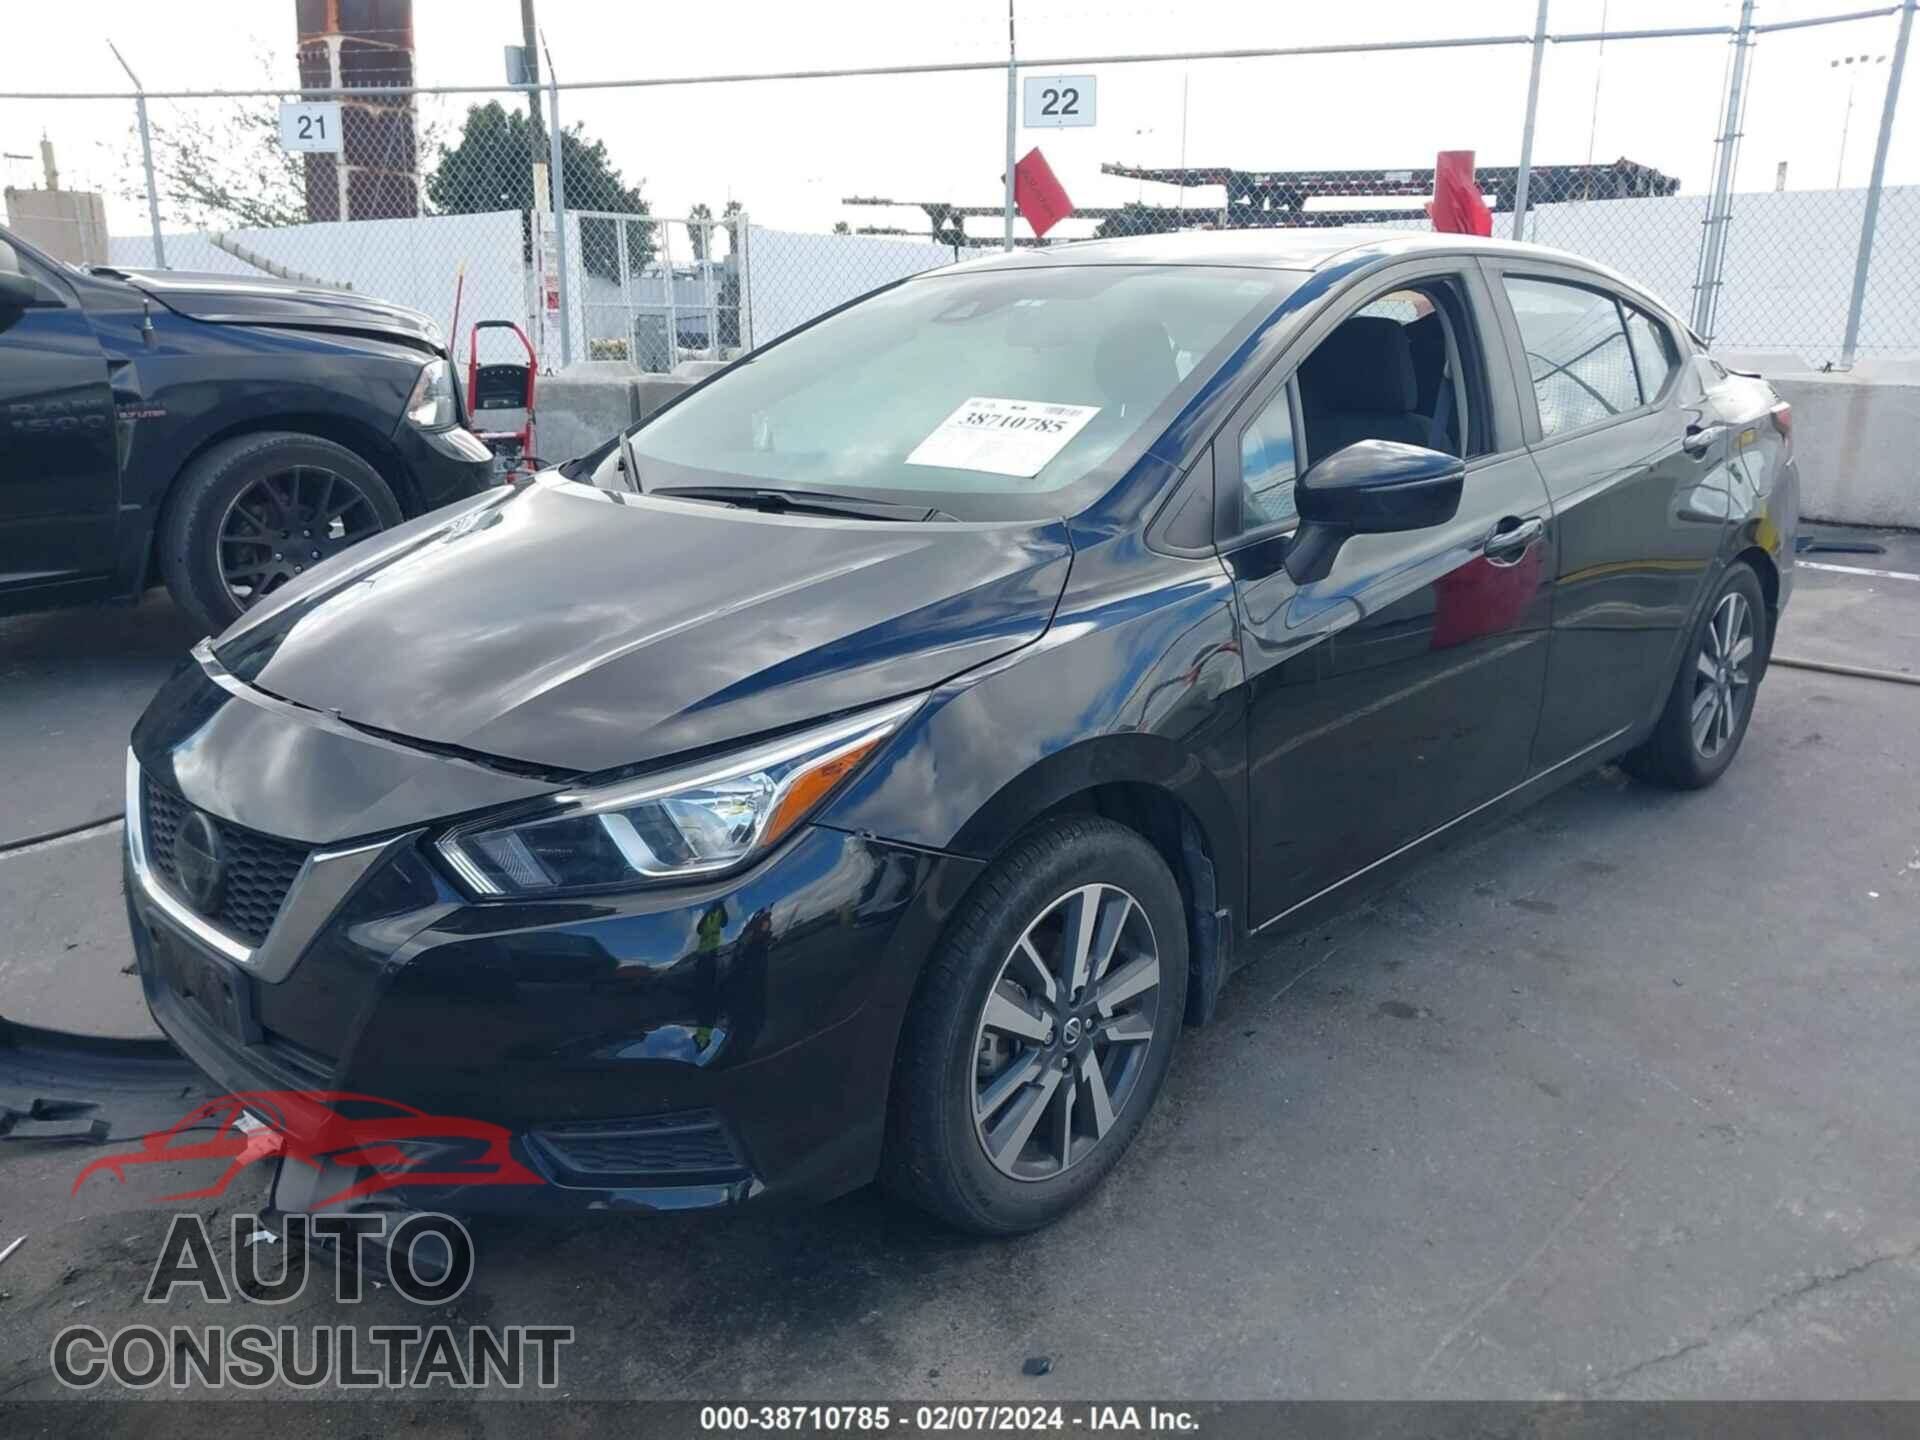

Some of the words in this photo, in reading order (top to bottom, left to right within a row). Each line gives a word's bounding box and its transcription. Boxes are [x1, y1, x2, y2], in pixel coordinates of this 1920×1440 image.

[1041, 87, 1080, 115] 22
[297, 115, 326, 140] 21
[958, 412, 1068, 433] 38710785
